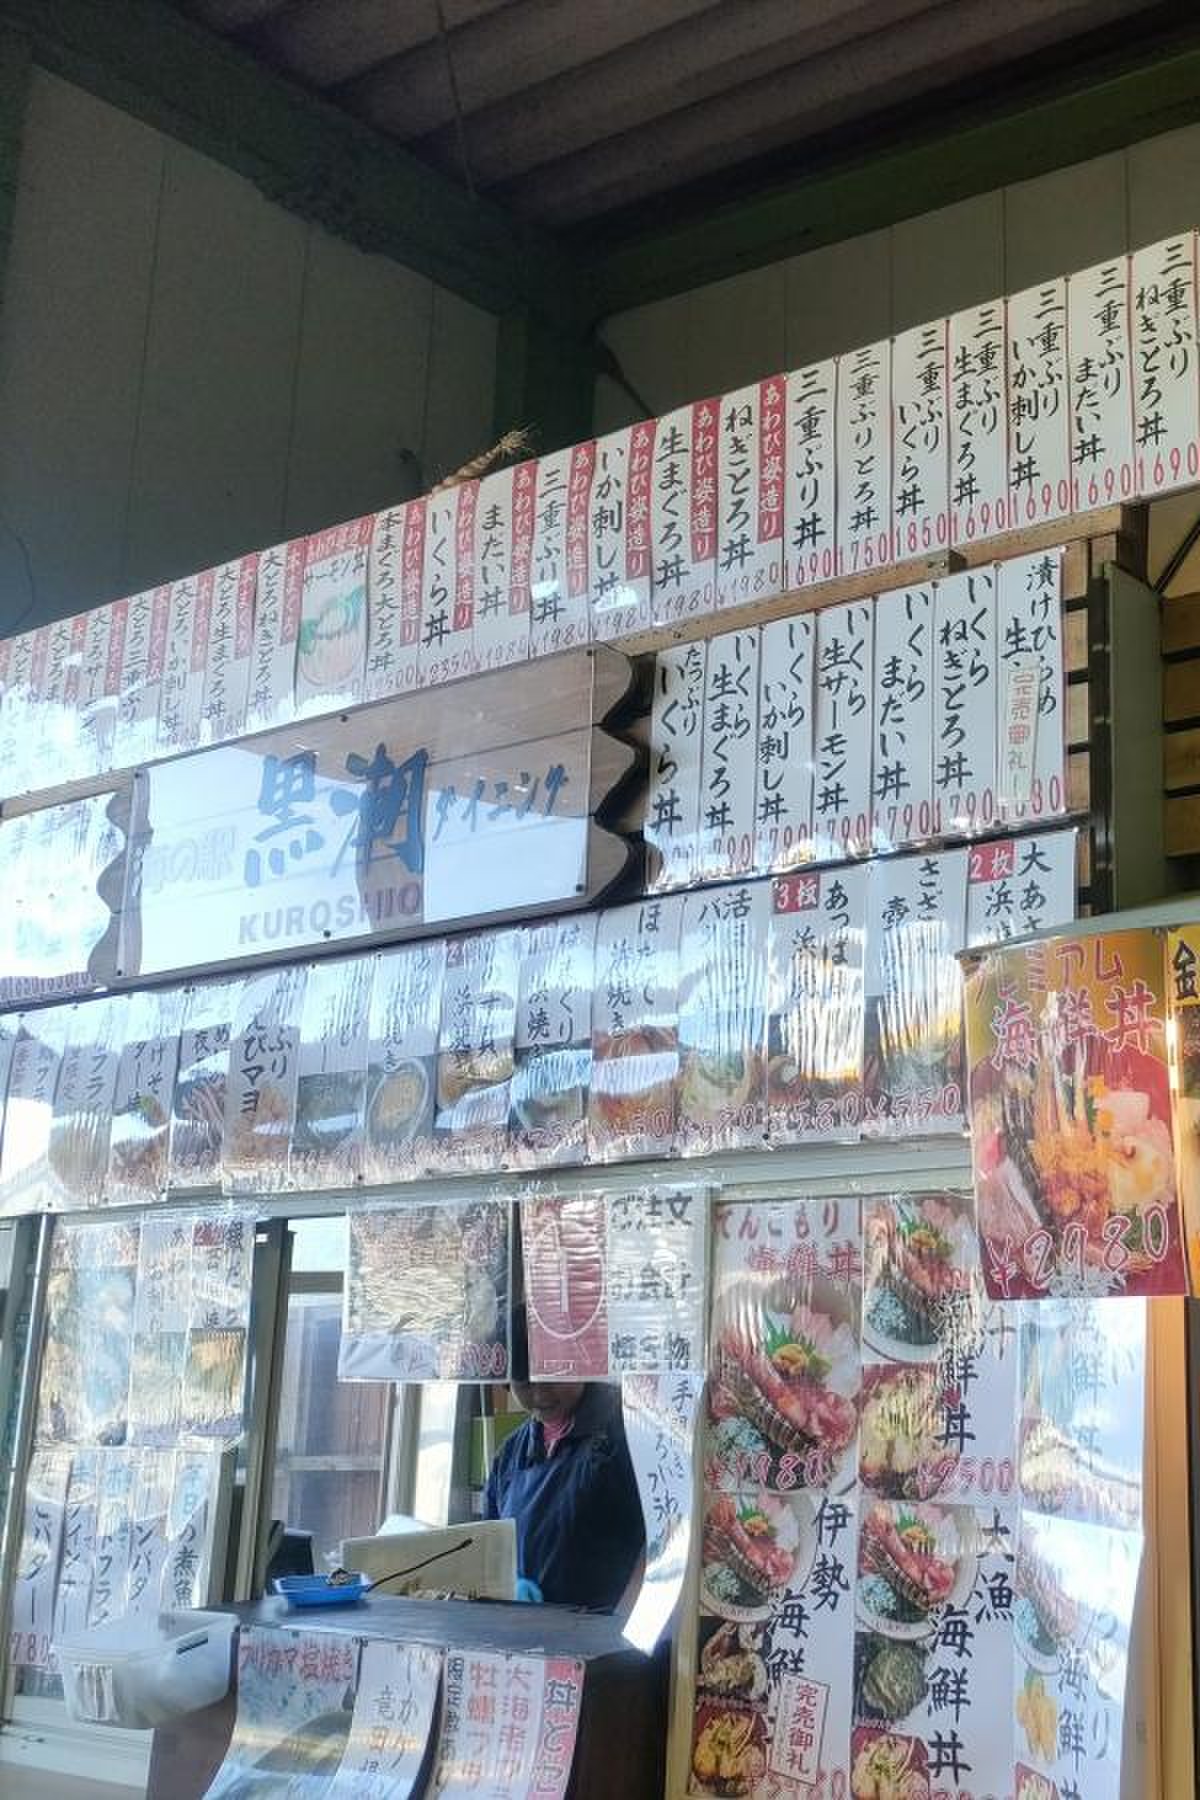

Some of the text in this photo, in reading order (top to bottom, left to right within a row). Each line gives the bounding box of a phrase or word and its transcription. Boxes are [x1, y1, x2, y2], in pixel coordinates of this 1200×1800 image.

[1010, 337, 1042, 491] いか刺し丼
[1135, 285, 1169, 448] ねぎとろ丼
[896, 401, 926, 516] いくら丼
[952, 345, 981, 508] 生まぐろ丼
[1073, 462, 1133, 506] 1690
[1137, 441, 1199, 492] 1690
[655, 426, 691, 590] 生まぐろ丼
[720, 403, 755, 572] ねぎとろ丼
[952, 493, 1006, 541] 1690
[1011, 478, 1069, 527] 1690
[735, 634, 757, 740] いくら
[788, 622, 811, 728] いくら
[846, 607, 870, 716] いくら
[904, 590, 930, 703] いくら
[966, 575, 993, 687] いくら
[650, 664, 686, 838] いくら丼
[704, 663, 738, 834] 生まぐろ丼
[756, 681, 791, 826] いか刺し丼
[815, 637, 850, 815] 生サーモン丼
[870, 655, 910, 800] まだい丼
[935, 618, 974, 789] ねぎとろ丼
[243, 742, 430, 889] 黒潮
[237, 880, 424, 945] KUROSHIO
[987, 1204, 1169, 1298] ¥2980
[811, 1497, 854, 1612] 伊勢
[974, 1506, 1016, 1624] 大漁
[785, 1683, 820, 1776] 完売御礼
[927, 1603, 976, 1786] 海鮮丼
